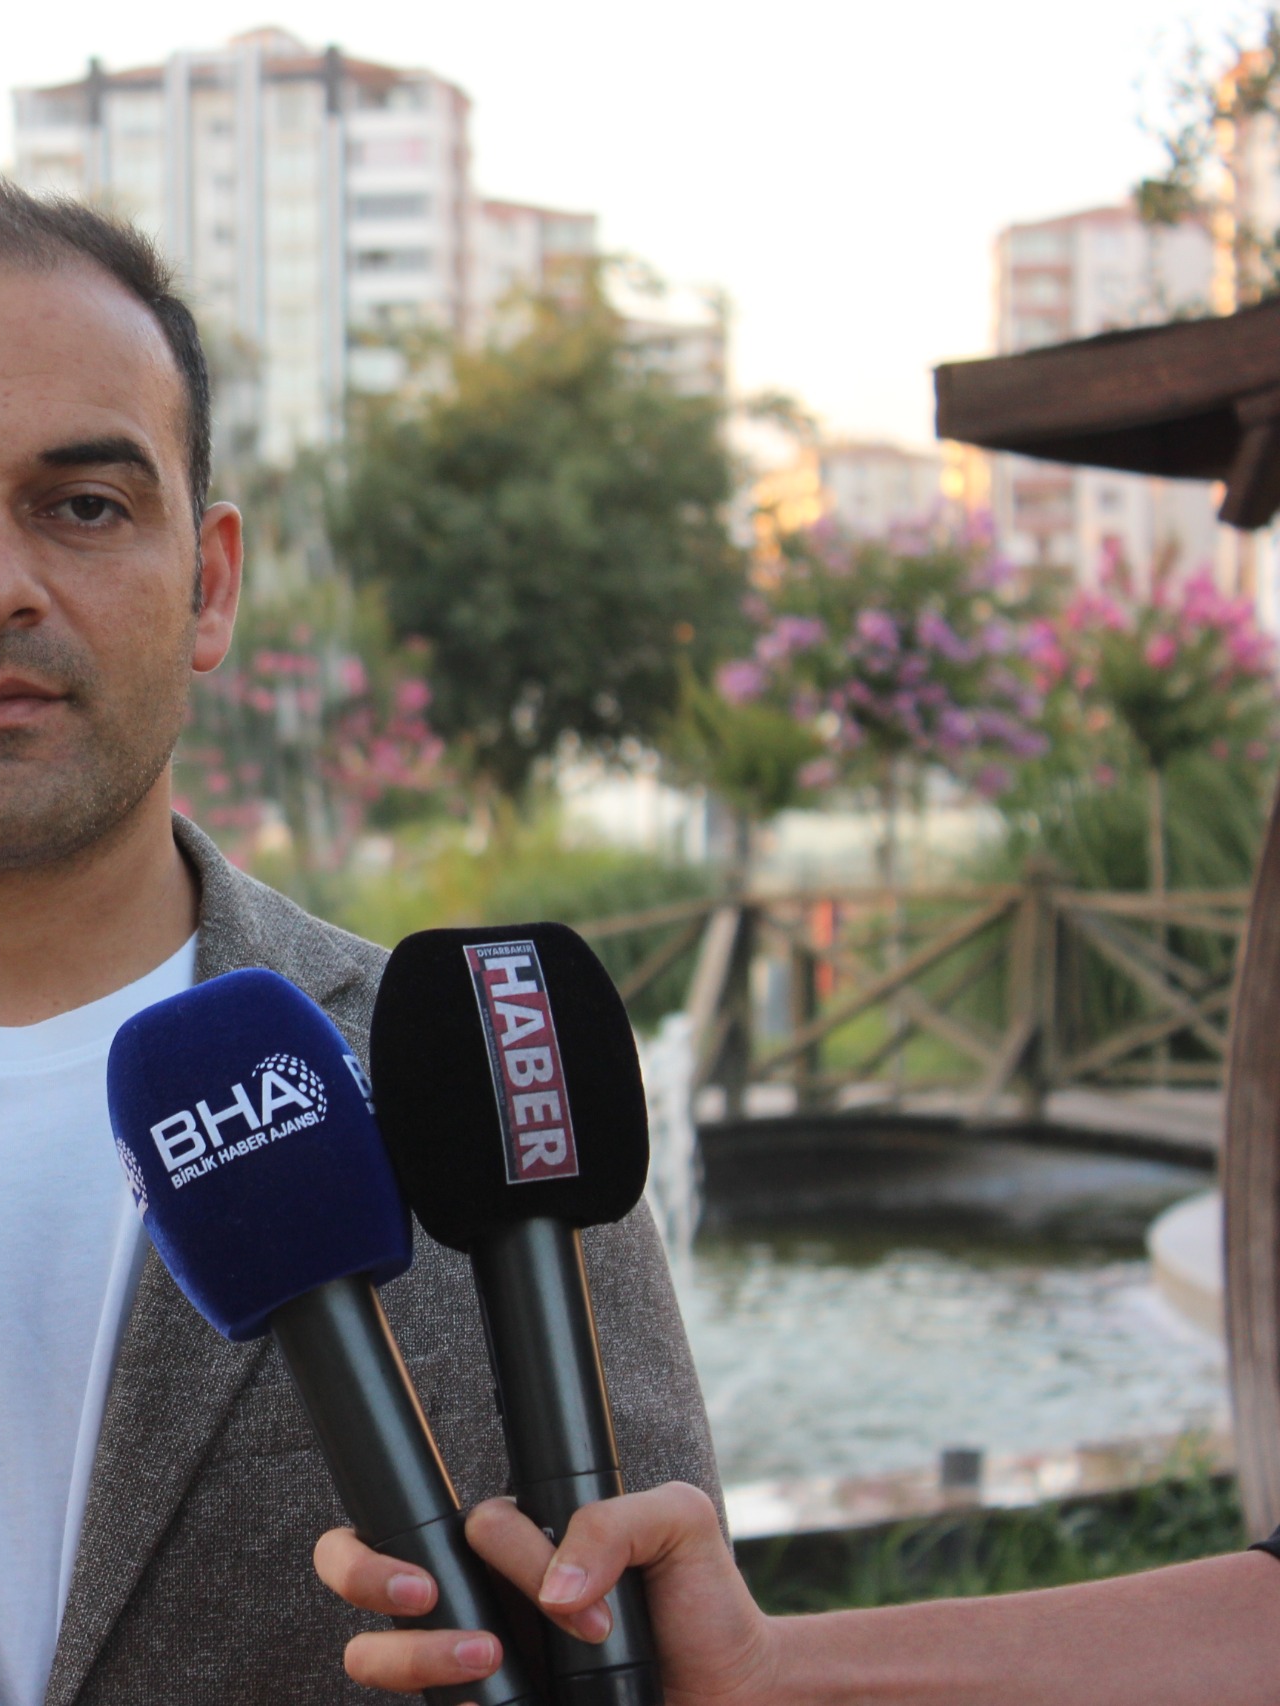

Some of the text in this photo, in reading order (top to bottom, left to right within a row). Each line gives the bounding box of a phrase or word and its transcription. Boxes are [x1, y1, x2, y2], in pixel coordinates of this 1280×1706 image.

[484, 955, 567, 1171] HABER
[150, 1070, 313, 1172] BHA
[171, 1155, 218, 1189] BİRLİK
[218, 1132, 269, 1164] HABER
[270, 1111, 319, 1142] AJANSI
